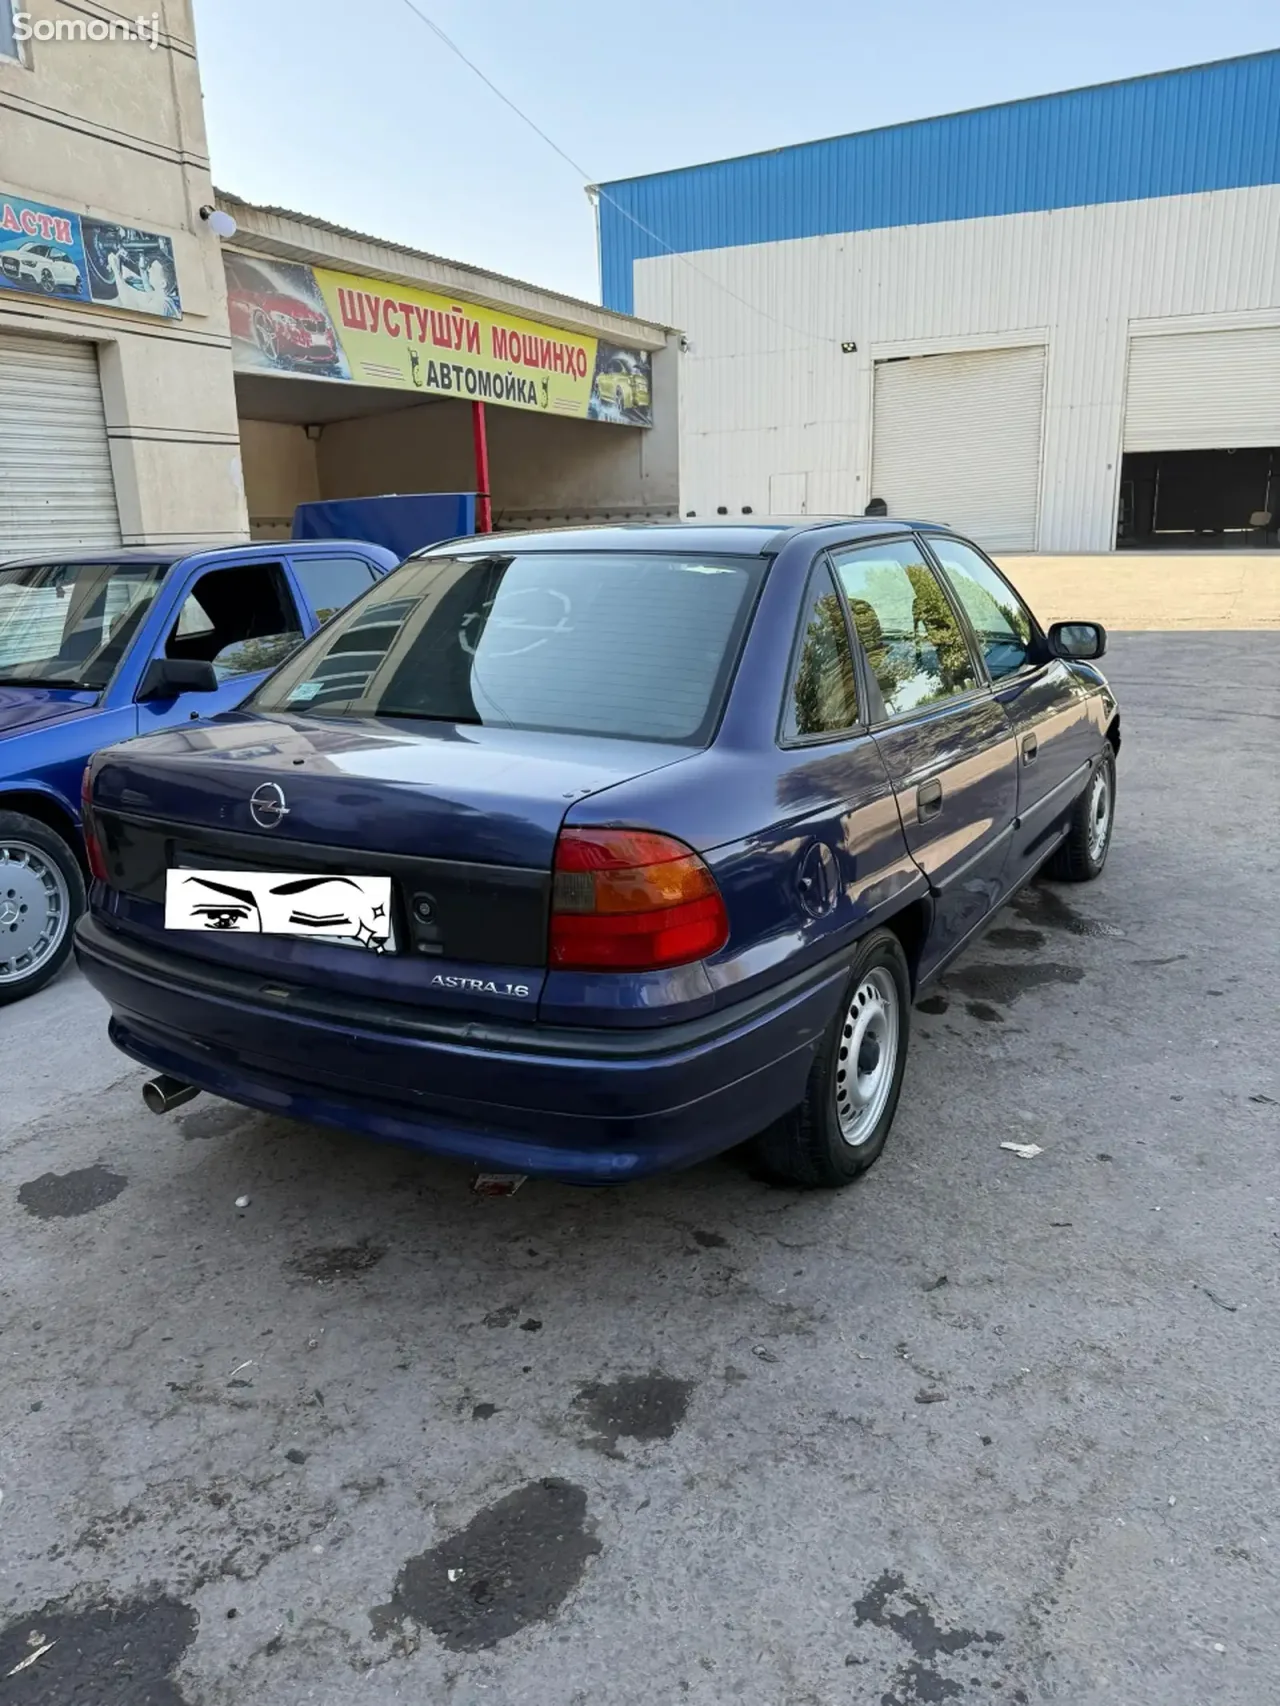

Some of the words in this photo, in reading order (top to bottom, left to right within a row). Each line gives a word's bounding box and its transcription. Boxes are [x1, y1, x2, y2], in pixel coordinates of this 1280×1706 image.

[0, 204, 74, 245] АСТИ
[337, 287, 481, 355] ШУСТУШӮИ
[491, 325, 587, 382] МОШИНҲО
[427, 360, 538, 405] АВТОМОЙКА
[431, 974, 497, 994] ASTRA
